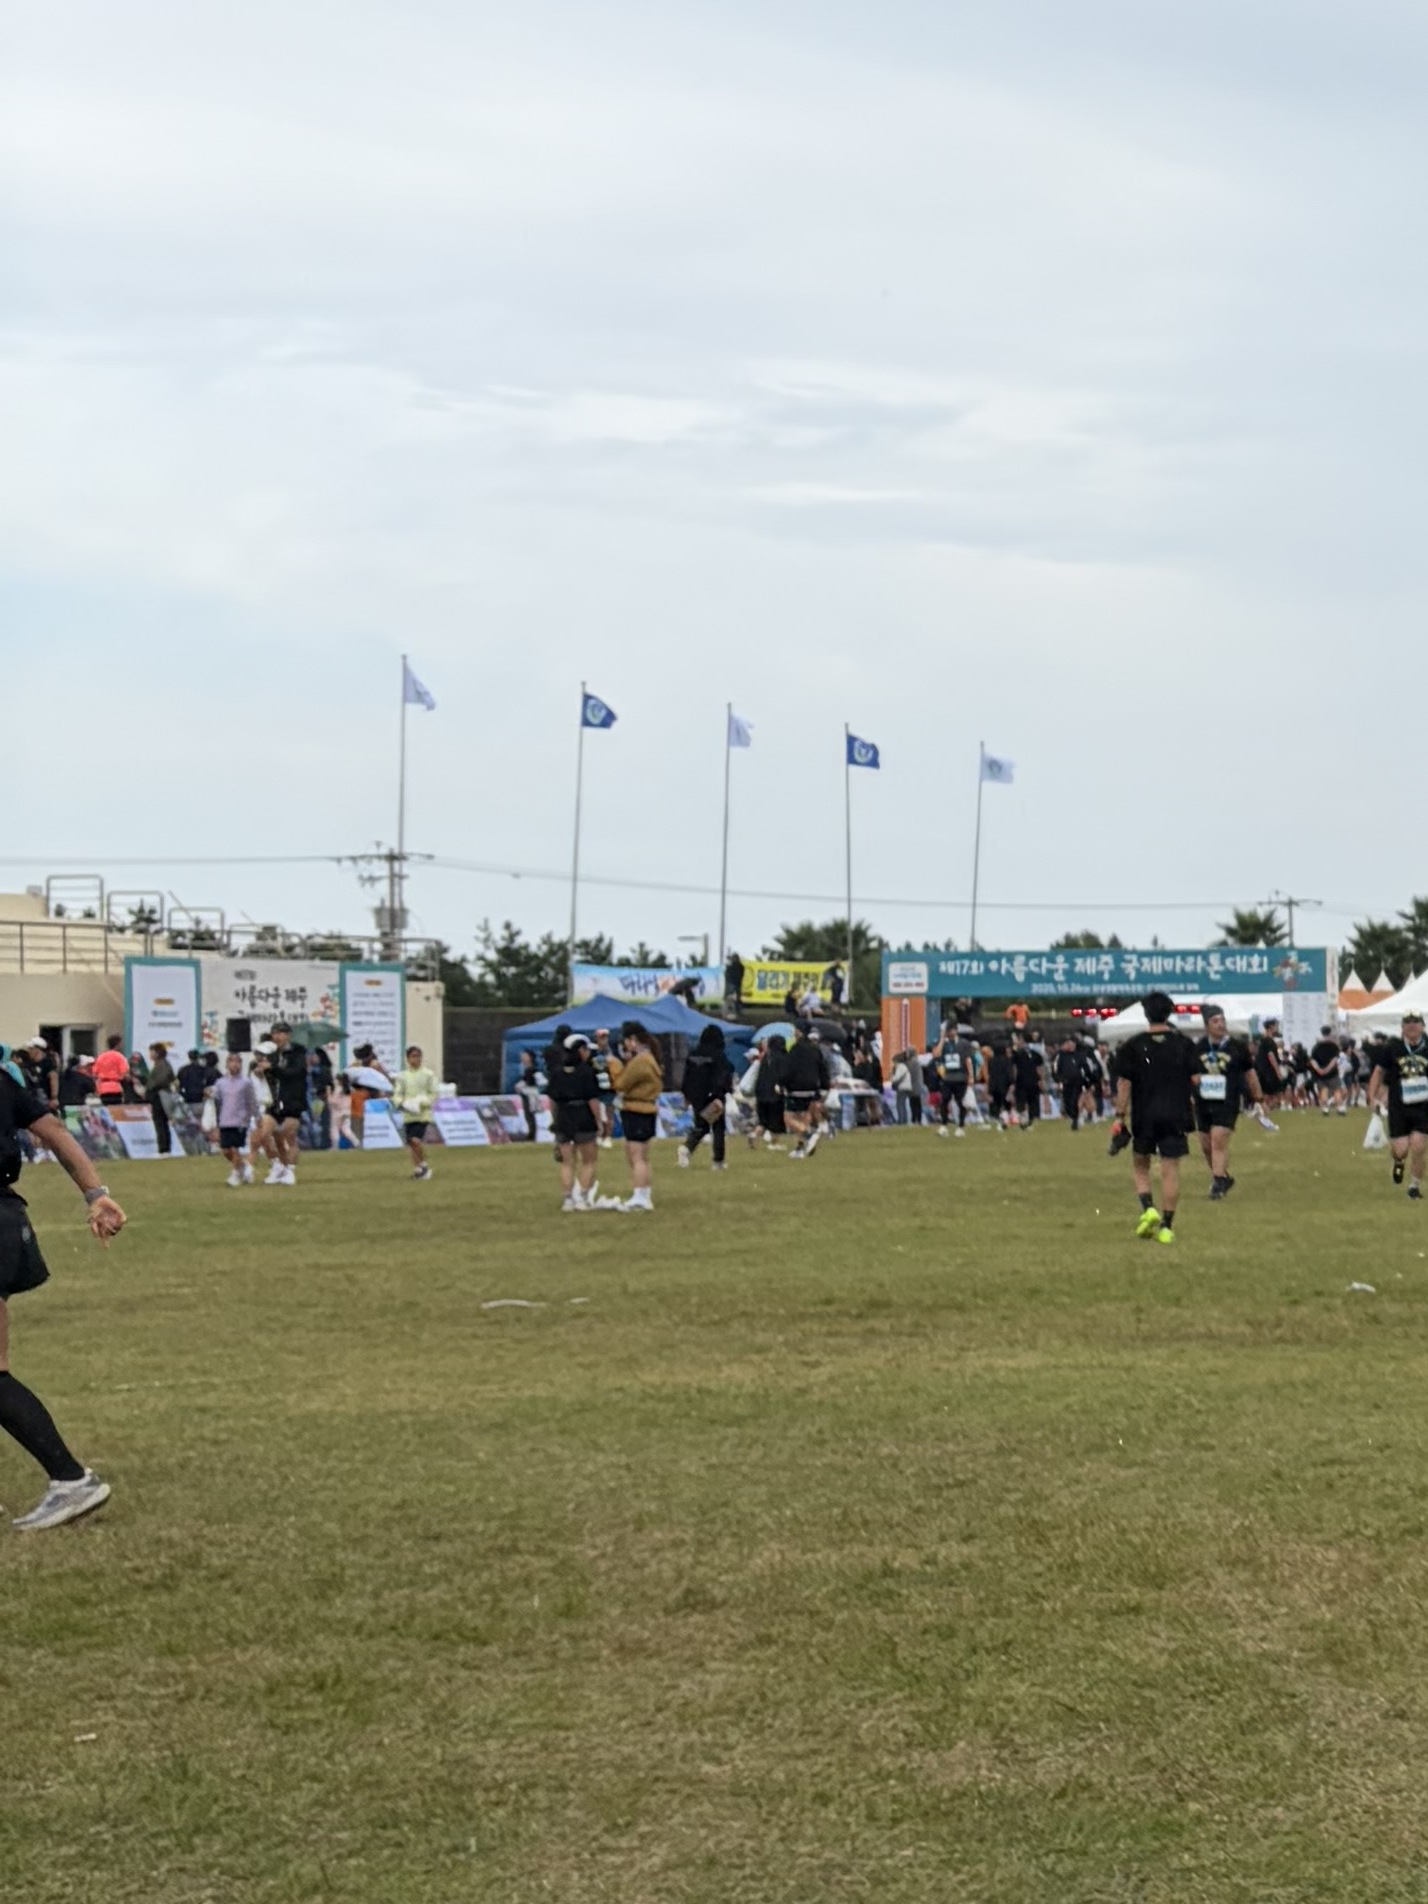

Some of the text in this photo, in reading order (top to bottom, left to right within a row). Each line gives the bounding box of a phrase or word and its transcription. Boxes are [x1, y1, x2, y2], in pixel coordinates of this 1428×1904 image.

[939, 959, 984, 976] 제17회
[988, 954, 1069, 983] 아름다운
[1074, 954, 1115, 981] 제주
[1120, 952, 1268, 981] 국제마라톤대회
